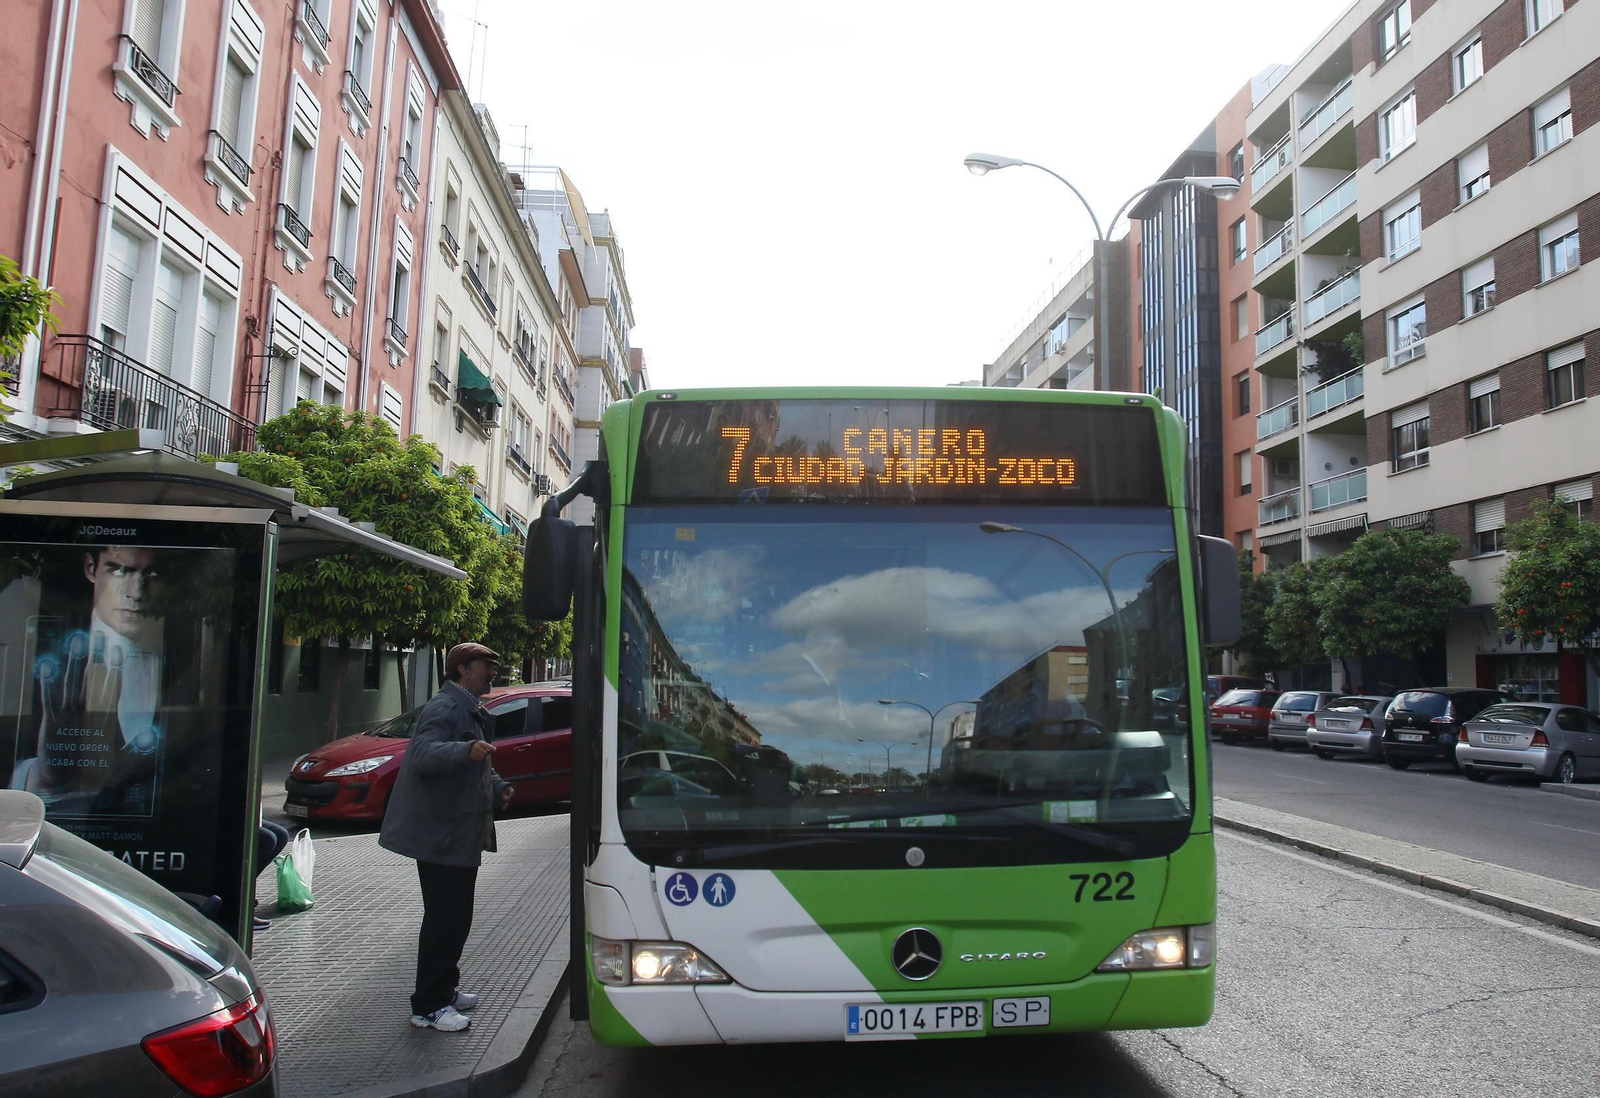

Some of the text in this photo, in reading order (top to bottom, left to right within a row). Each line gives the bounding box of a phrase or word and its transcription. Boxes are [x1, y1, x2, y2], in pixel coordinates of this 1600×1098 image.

[721, 427, 750, 483] 7
[753, 456, 1075, 485] CIUDAD JARDIN-ZOCO
[79, 525, 137, 536] JCDecaux
[56, 727, 105, 737] ACCEDE AL
[46, 743, 112, 752] NUEVO ORDEN.
[45, 757, 110, 768] ACABA CON ÉL
[88, 832, 111, 840] MATT
[112, 832, 144, 841] DAMON
[108, 850, 185, 871] ATED
[1069, 871, 1135, 903] 722
[959, 951, 1047, 963] CITARO
[864, 1007, 926, 1031] 0014
[935, 1005, 979, 1029] FPB
